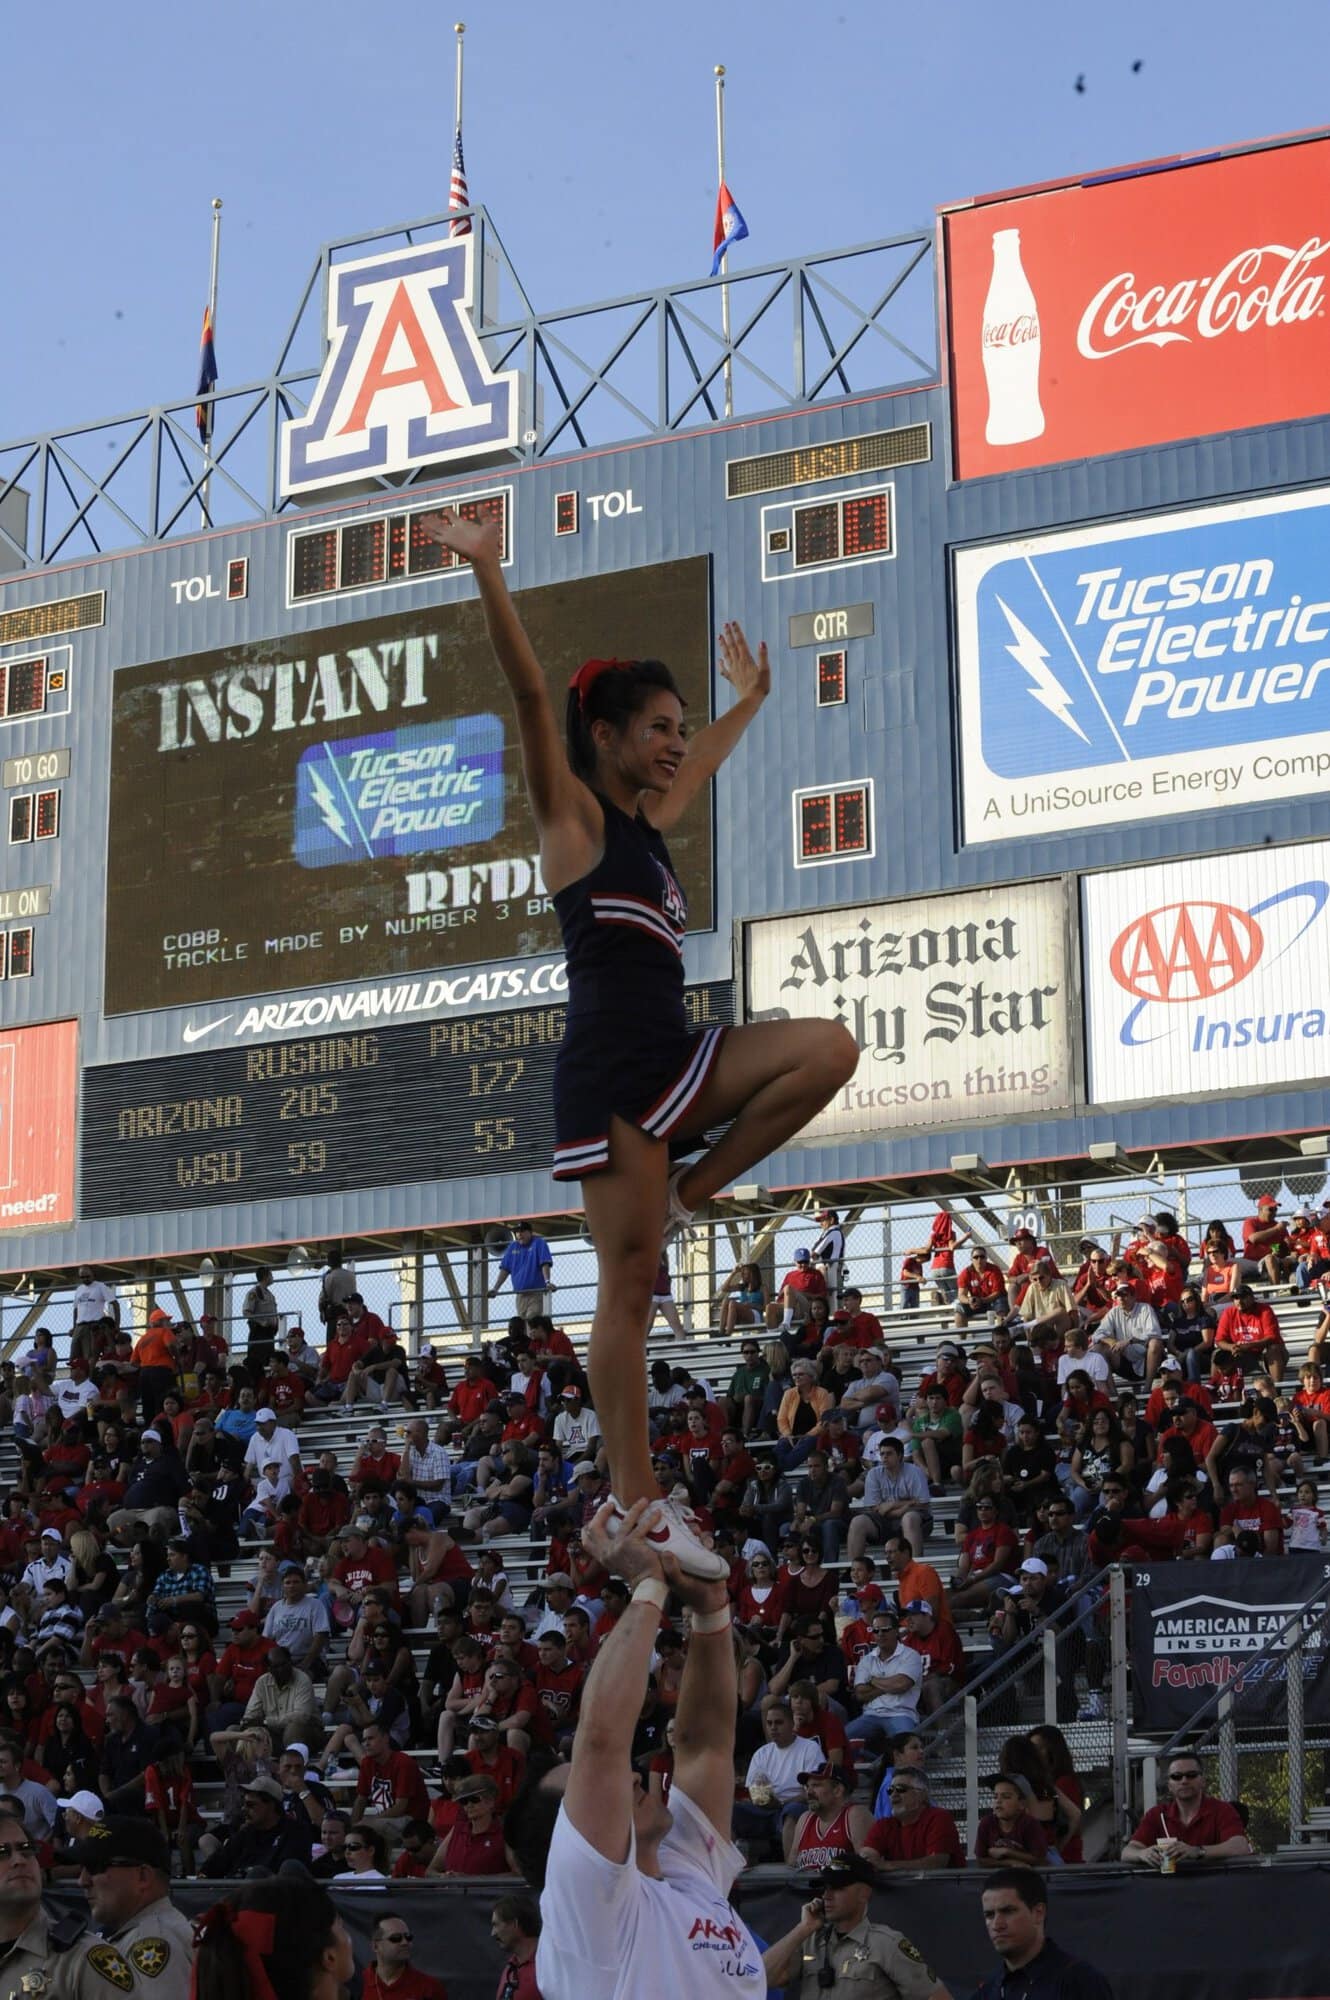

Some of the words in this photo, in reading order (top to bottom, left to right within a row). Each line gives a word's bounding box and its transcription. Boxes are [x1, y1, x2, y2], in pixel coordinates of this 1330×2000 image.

[1077, 237, 1330, 359] Coca-Cola
[282, 236, 517, 494] A
[794, 442, 858, 482] WSU
[586, 489, 643, 521] TOL
[171, 574, 221, 604] TOL
[1075, 558, 1274, 625] Tucson
[812, 609, 849, 642] QTR
[1097, 595, 1330, 673] Electric
[157, 634, 438, 752] INSTANT
[1123, 659, 1330, 726] Power
[14, 758, 32, 784] TO
[37, 753, 58, 779] GO
[348, 743, 455, 781] Tucson
[357, 765, 484, 810] Electric
[983, 798, 1001, 821] A
[1010, 780, 1143, 816] UniSource
[1152, 764, 1243, 795] Energy
[370, 800, 484, 840] Power
[18, 890, 40, 915] ON
[164, 943, 248, 970] TACKLE
[265, 932, 324, 954] MADE
[339, 924, 369, 944] BY
[385, 908, 478, 936] NUMBER
[495, 903, 510, 921] 3
[779, 916, 1022, 991] Arizona
[1125, 902, 1253, 1001] AAA
[923, 980, 1058, 1046] Star
[1193, 1008, 1327, 1052] Insura
[247, 1033, 379, 1081] RUSHING
[430, 1008, 567, 1056] PASSING
[118, 1095, 243, 1140] ARIZONA
[280, 1080, 339, 1120] 205
[468, 1057, 525, 1096] 177
[964, 1063, 1059, 1101] thing.
[176, 1149, 242, 1188] WSU
[287, 1140, 327, 1175] 59
[474, 1116, 517, 1153] 55
[1, 1193, 58, 1218] need?
[1136, 1573, 1150, 1587] 29
[1154, 1616, 1250, 1635] AMERICAN
[1152, 1656, 1246, 1692] Family
